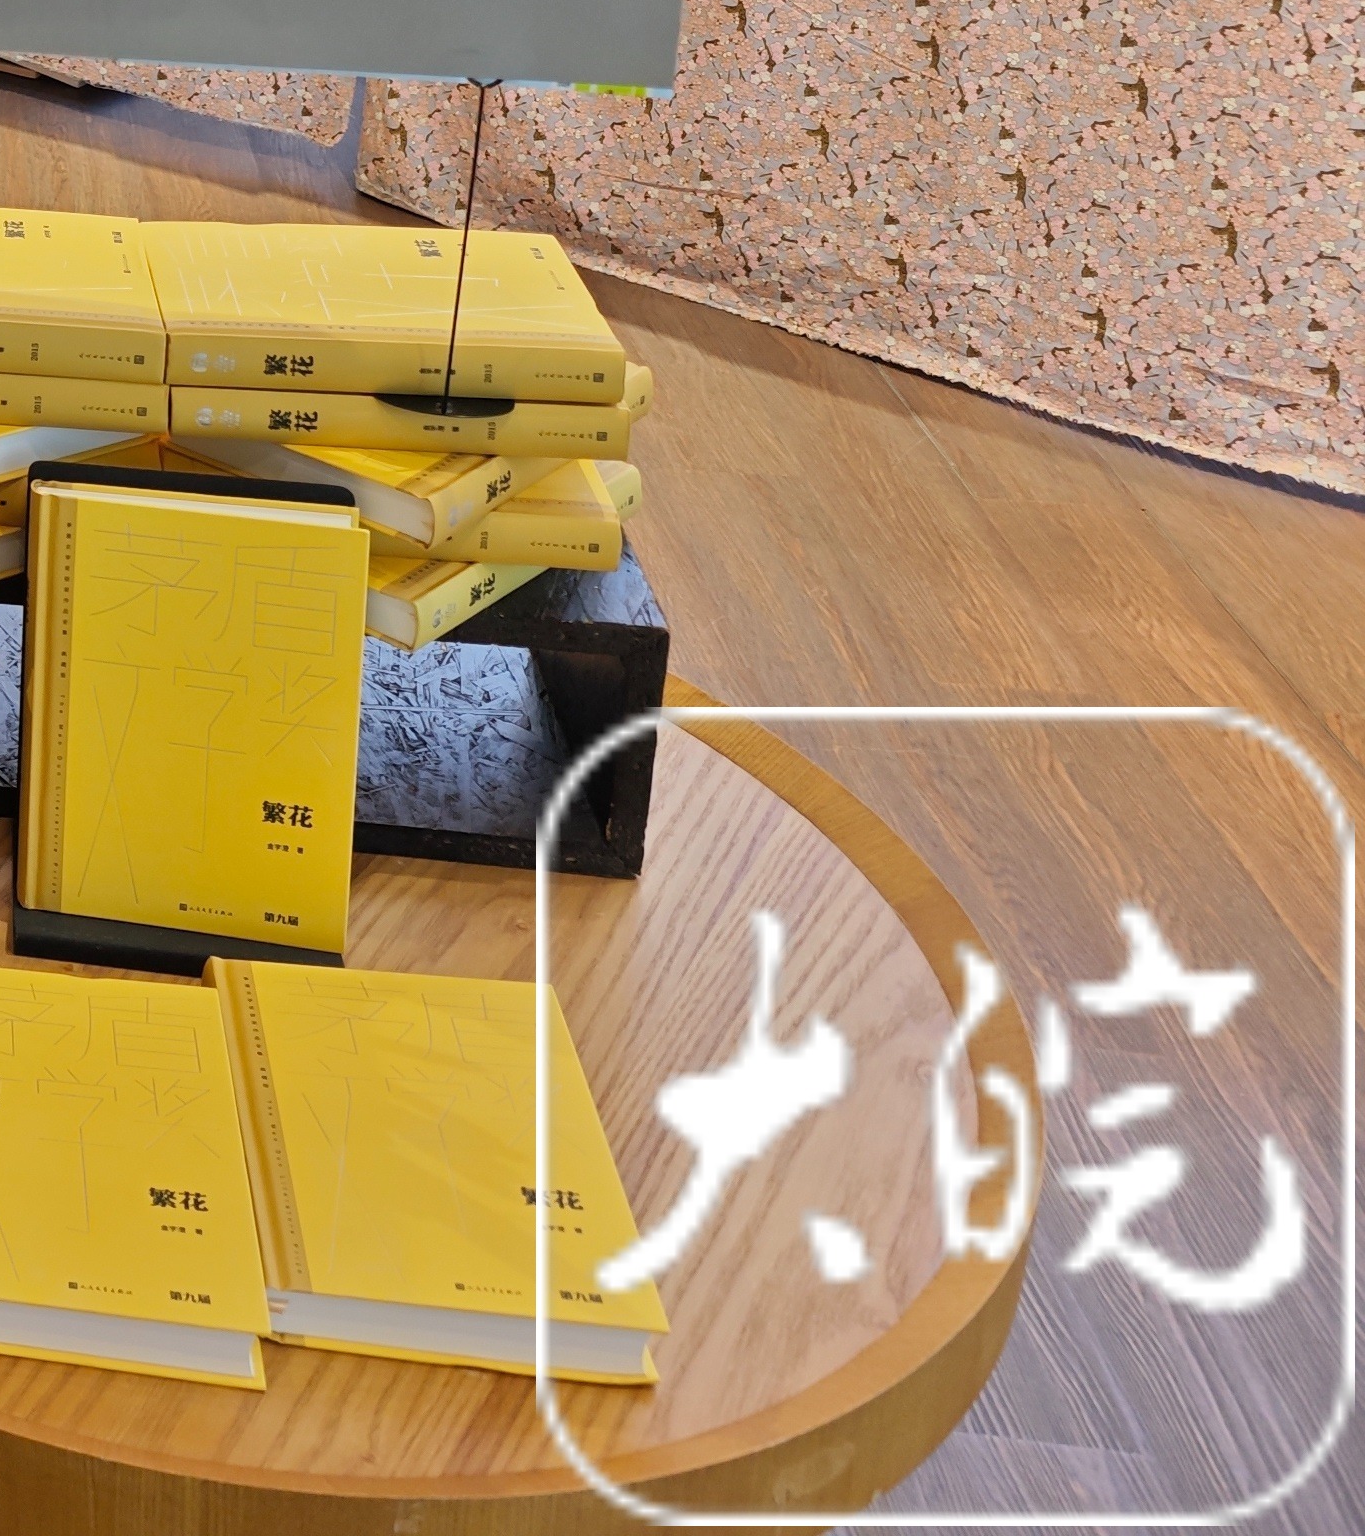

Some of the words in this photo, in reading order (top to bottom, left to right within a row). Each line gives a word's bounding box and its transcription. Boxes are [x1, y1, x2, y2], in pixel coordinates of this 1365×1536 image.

[264, 354, 314, 377] 繁花
[268, 409, 318, 433] 繁花
[262, 800, 314, 829] 繁花
[264, 911, 299, 926] 第九届
[149, 1186, 209, 1212] 繁花
[169, 1289, 211, 1305] 第九届
